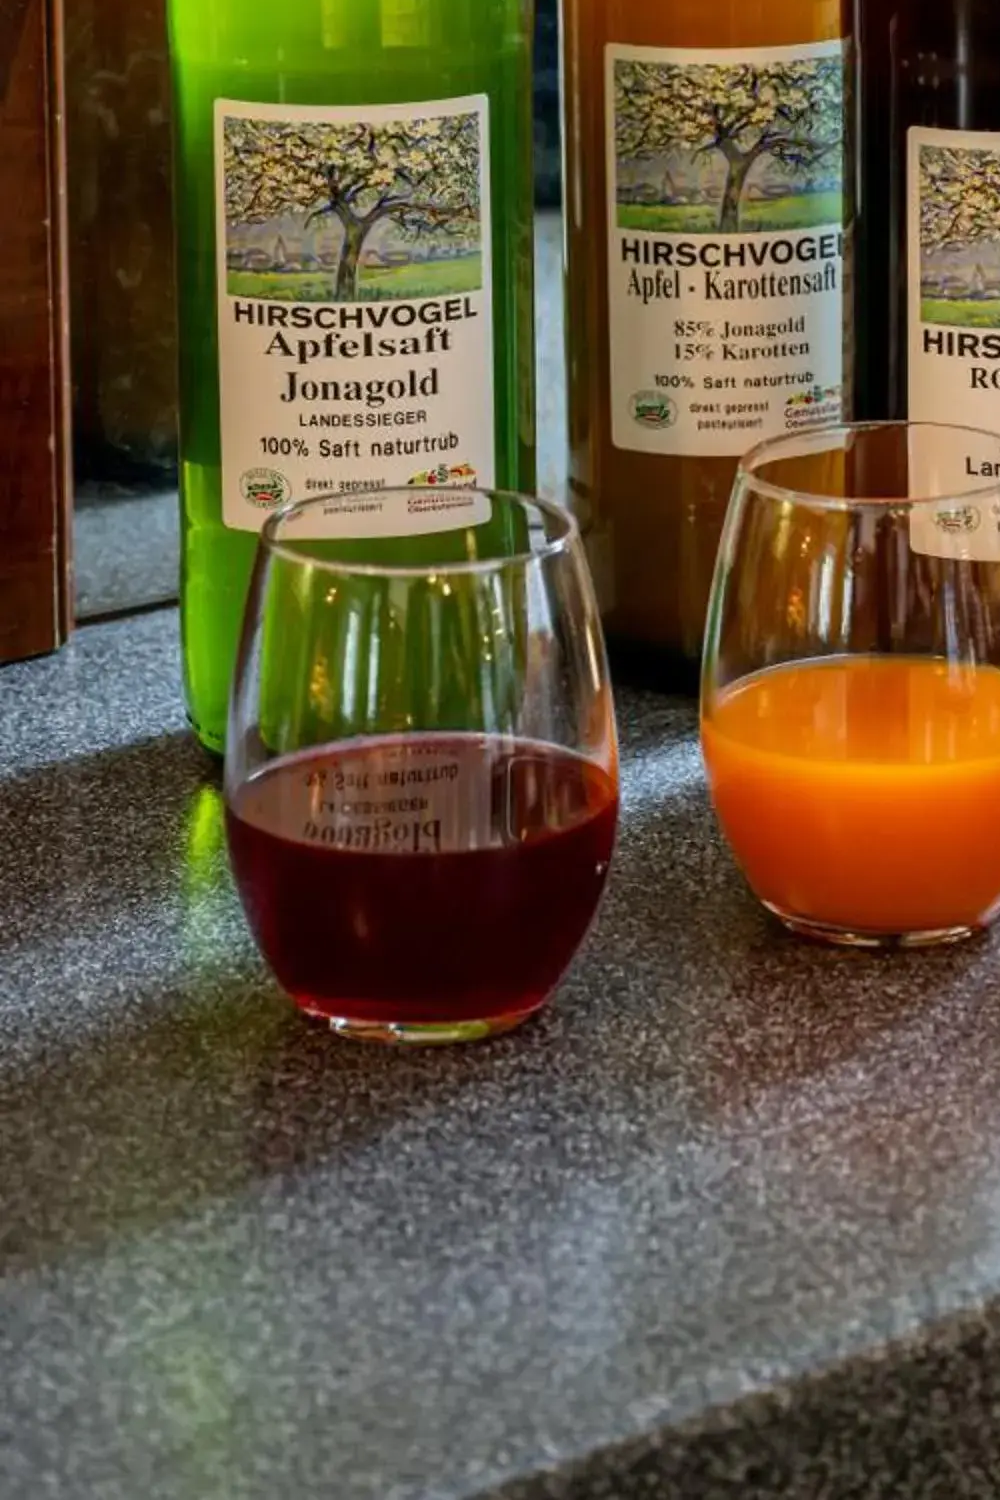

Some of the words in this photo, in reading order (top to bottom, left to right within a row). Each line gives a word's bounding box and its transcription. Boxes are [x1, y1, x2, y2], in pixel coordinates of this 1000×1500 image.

[627, 268, 680, 305] Apfel
[704, 262, 837, 301] Karottensaft
[234, 297, 478, 329] HIRSCHVOGEL
[674, 319, 715, 338] 85%
[720, 315, 806, 339] Jonagold
[264, 326, 452, 365] Apfelsaft
[674, 343, 715, 361] 15%
[722, 342, 810, 361] Karotten
[280, 367, 439, 408] Jonagold
[654, 373, 695, 389] 100%
[703, 375, 736, 389] Saft
[299, 410, 427, 428] LANDESSIEGER
[260, 436, 309, 457] 100%
[319, 438, 360, 459] Saft
